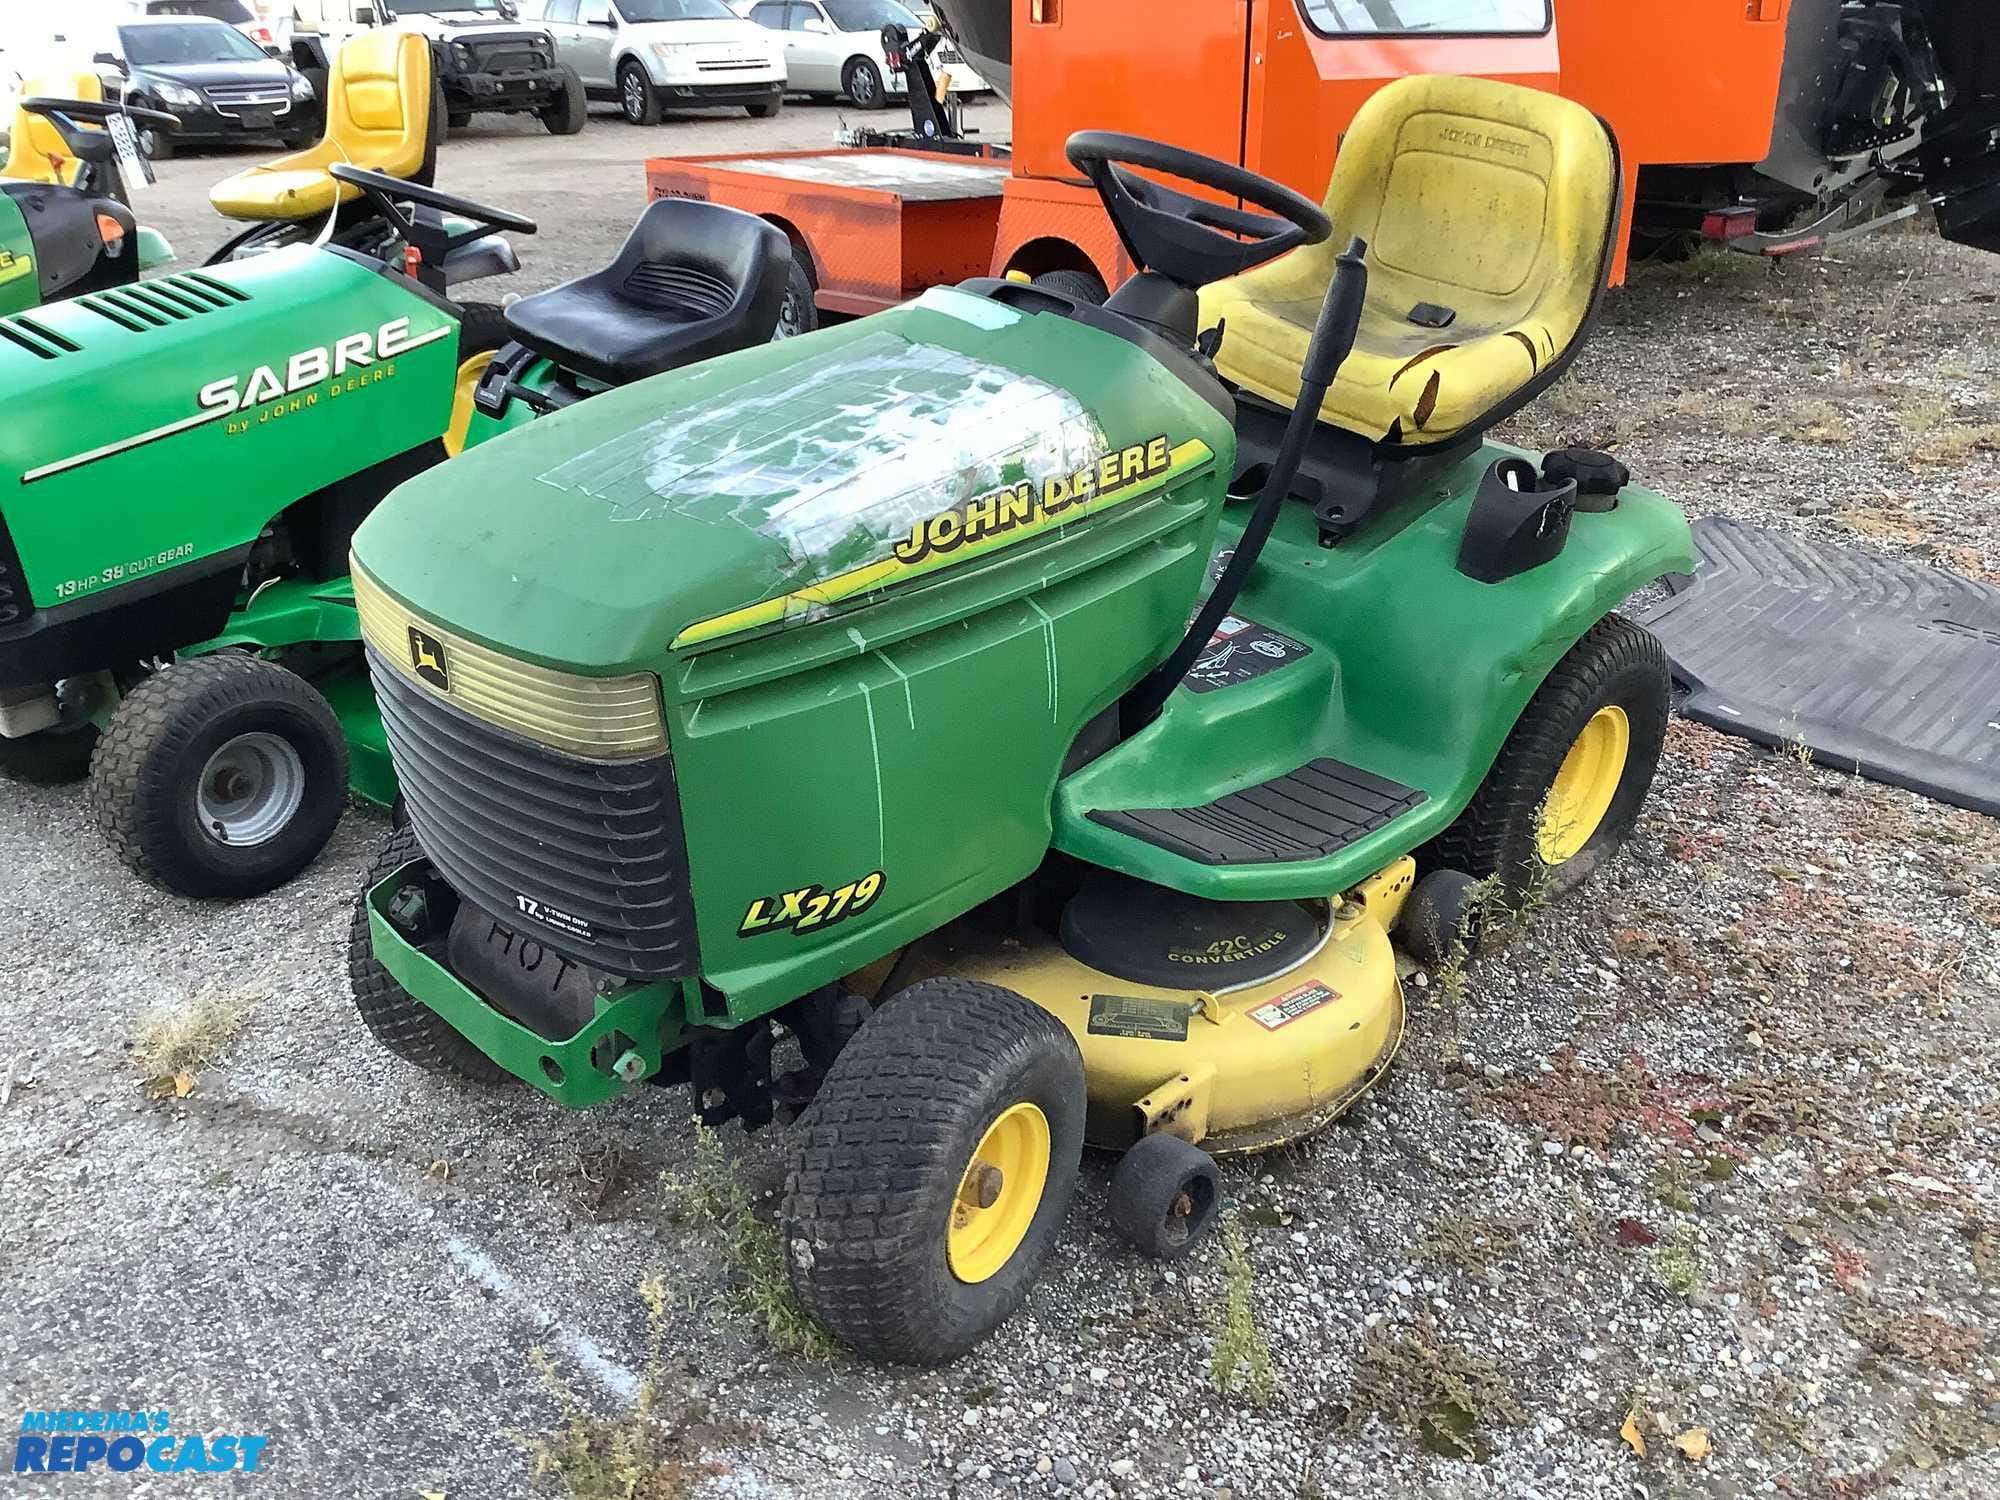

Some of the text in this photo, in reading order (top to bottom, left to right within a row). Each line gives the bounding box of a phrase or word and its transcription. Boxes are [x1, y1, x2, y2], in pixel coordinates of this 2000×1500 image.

[199, 316, 413, 409] SABRE
[227, 364, 396, 435] by JOHN DEERE
[895, 436, 1171, 563] JOHN DEERE
[157, 542, 193, 564] GEAR
[544, 906, 571, 922] V-TWIN
[737, 872, 885, 936] LX279
[487, 922, 578, 991] HOT
[1168, 930, 1287, 964] CONVERTIBLE
[1207, 935, 1251, 955] 42C
